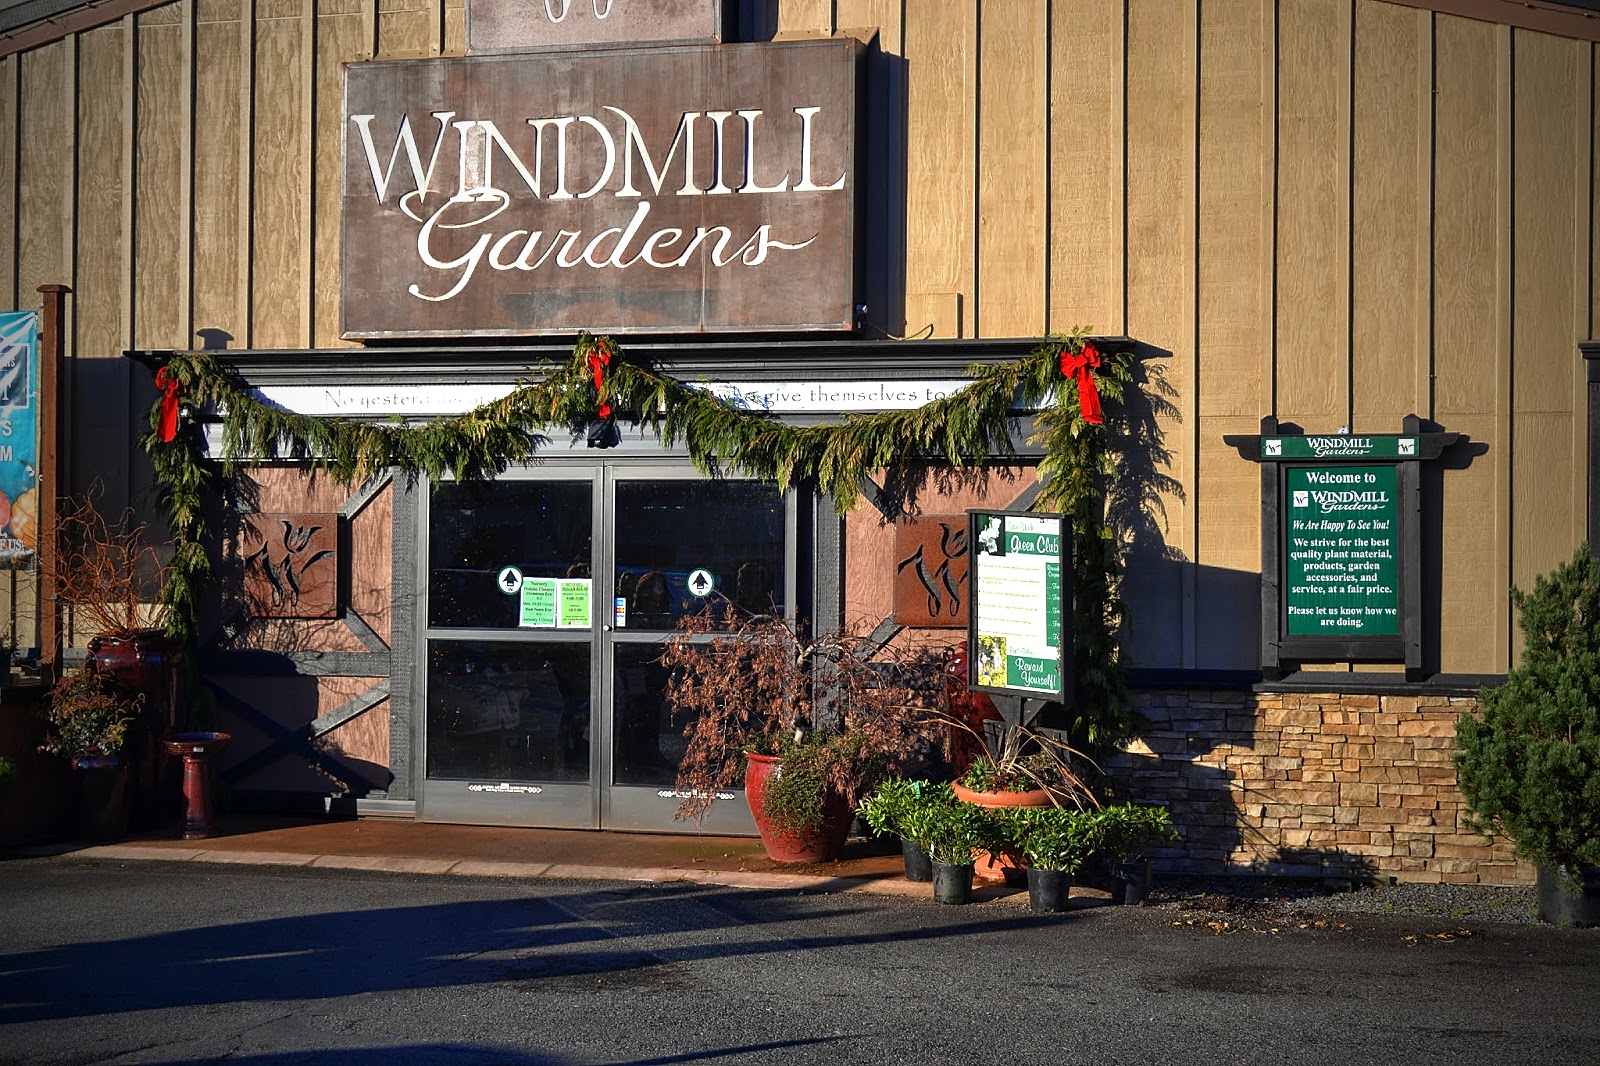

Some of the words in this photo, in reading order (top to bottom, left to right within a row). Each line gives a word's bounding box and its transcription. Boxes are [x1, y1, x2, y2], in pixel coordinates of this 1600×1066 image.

[349, 105, 846, 204] WINDMILL
[399, 189, 819, 301] Gardens
[325, 389, 354, 407] No
[764, 388, 802, 407] give
[810, 383, 918, 402] themselves
[926, 388, 946, 401] to
[1306, 437, 1373, 448] WINDMILL
[1314, 446, 1370, 458] Gardens
[1306, 471, 1360, 484] Welcome
[1364, 472, 1376, 484] to
[1310, 490, 1389, 503] WINDMILL
[1319, 500, 1386, 514] Gardens
[1293, 519, 1304, 530] We
[1305, 519, 1320, 530] Are
[1321, 519, 1346, 532] Happy
[1347, 519, 1355, 530] To
[1357, 519, 1371, 530] See
[1373, 519, 1390, 530] You!
[1011, 534, 1035, 554] Green
[1036, 535, 1059, 554] Club
[1293, 538, 1308, 547] We
[1310, 537, 1336, 547] strive
[1338, 537, 1352, 547] for
[1354, 538, 1369, 547] the
[1371, 537, 1390, 547] best
[1290, 549, 1323, 560] quality
[1324, 549, 1349, 560] plant
[1351, 549, 1393, 559] material,
[1303, 561, 1346, 572] products,
[1348, 561, 1380, 572] garden
[1305, 573, 1358, 583] accessories,
[1360, 573, 1378, 582] and
[1291, 584, 1326, 595] service,
[1328, 585, 1338, 593] at
[1347, 584, 1364, 593] fair
[1366, 584, 1393, 595] price.
[1288, 606, 1314, 615] Please
[1316, 606, 1327, 615] let
[1340, 606, 1363, 615] know
[1365, 606, 1383, 615] how
[1336, 617, 1364, 628] doing.
[1015, 657, 1044, 672] Reward
[1021, 670, 1056, 690] Yourself!
